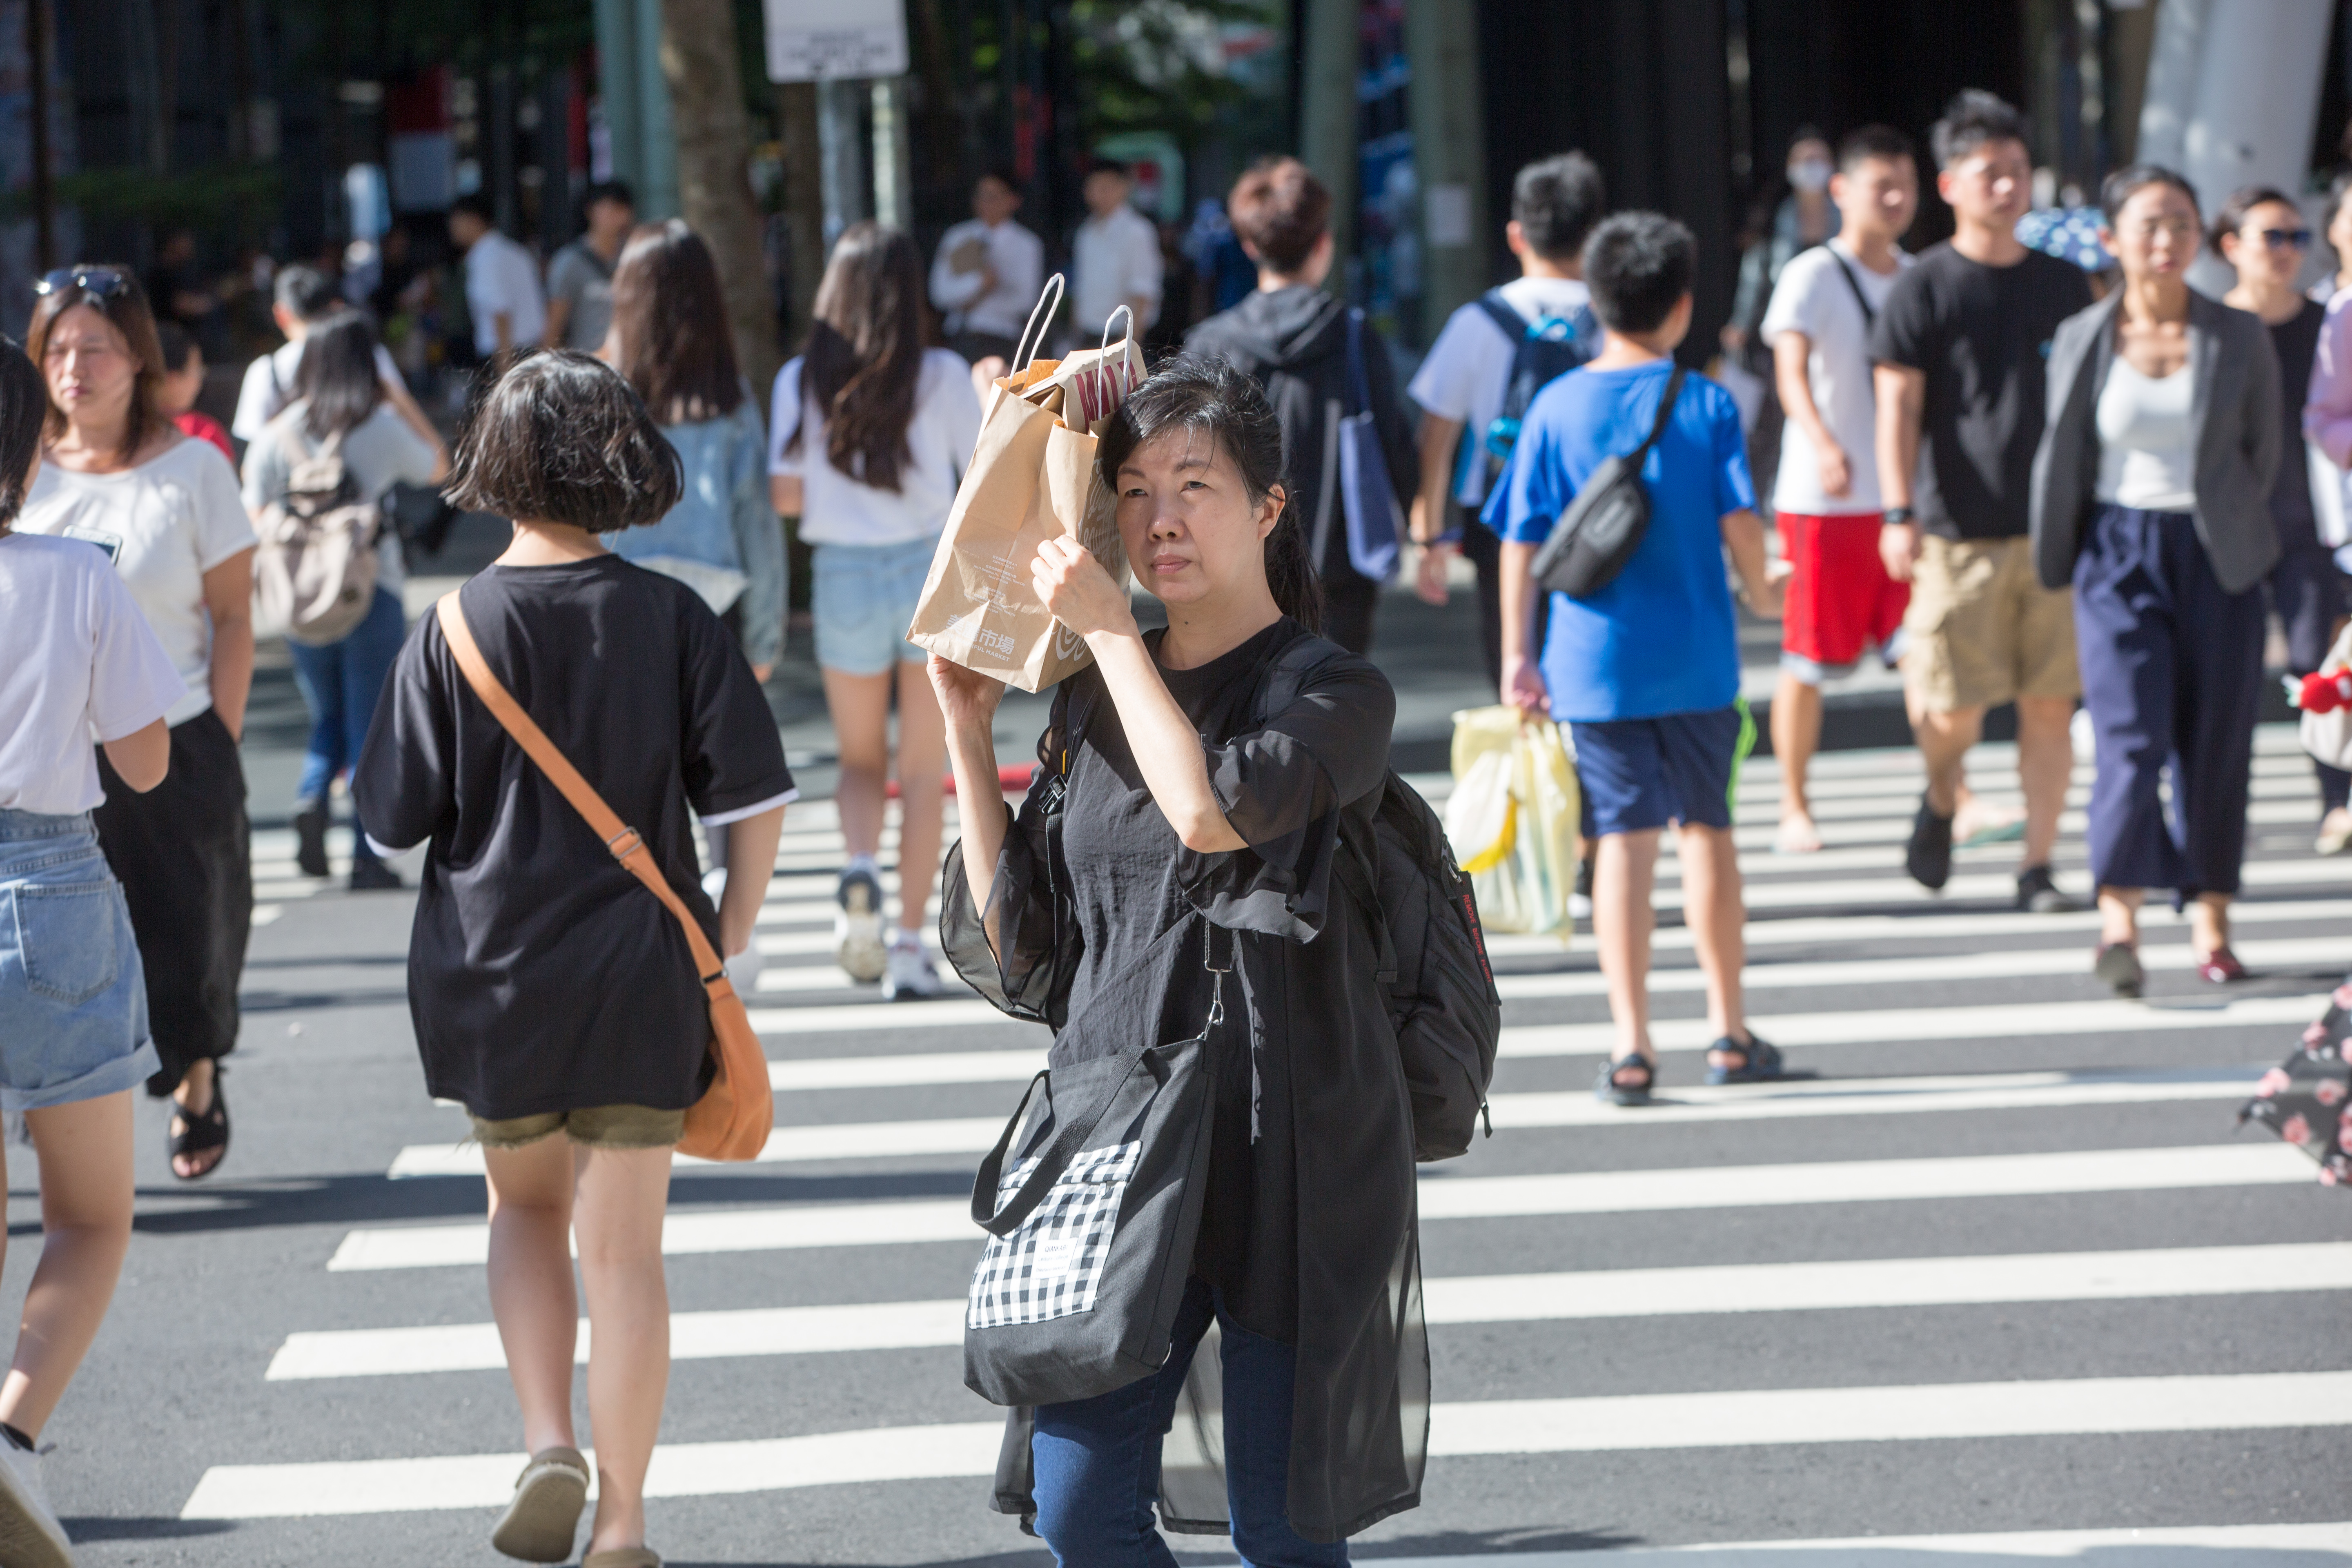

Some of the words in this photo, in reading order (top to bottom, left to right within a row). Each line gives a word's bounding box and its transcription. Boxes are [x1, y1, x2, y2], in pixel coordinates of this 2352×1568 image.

[946, 614, 1015, 655] 美麗市場
[955, 637, 984, 653] BEAUTIFUL
[986, 649, 1010, 662] MARKET
[1463, 894, 1476, 924] REMOVE
[1472, 928, 1483, 955] BEFORE
[1481, 959, 1492, 983] FLIGHT
